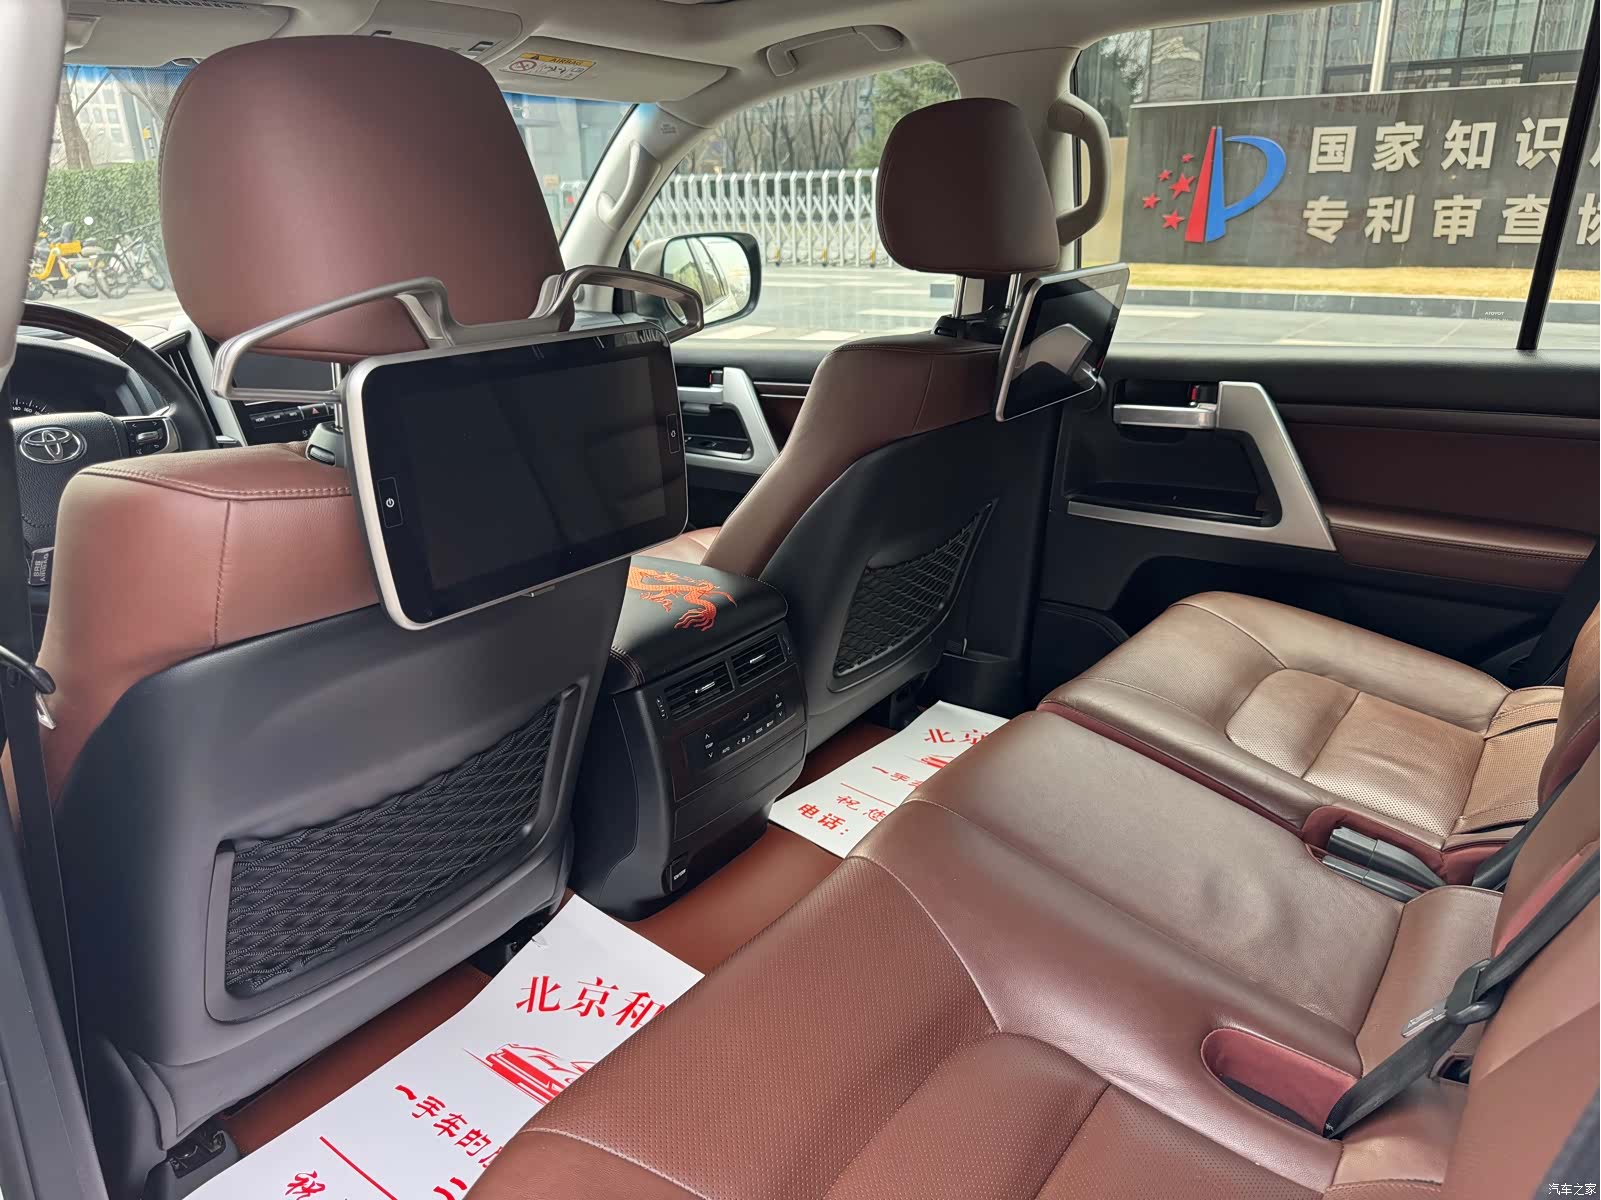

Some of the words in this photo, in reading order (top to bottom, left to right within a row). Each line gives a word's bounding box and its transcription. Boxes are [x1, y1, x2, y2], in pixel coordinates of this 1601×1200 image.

[551, 57, 584, 66] AIRBAG
[1308, 117, 1600, 173] 国家知识
